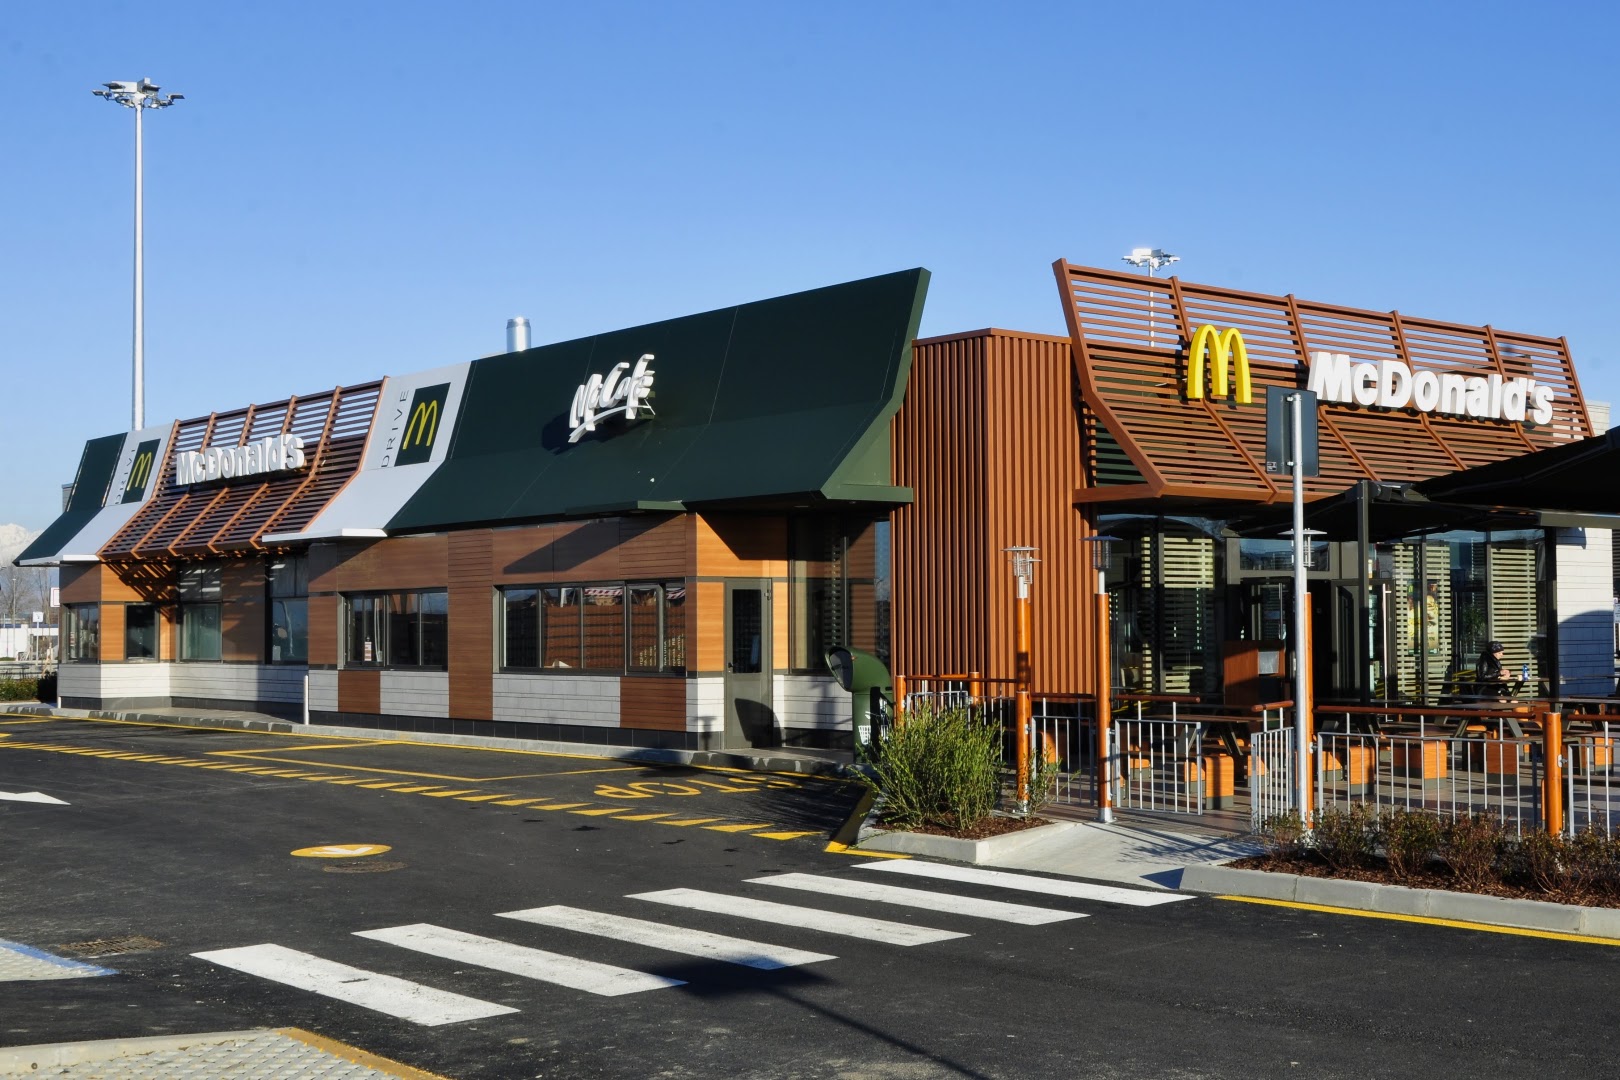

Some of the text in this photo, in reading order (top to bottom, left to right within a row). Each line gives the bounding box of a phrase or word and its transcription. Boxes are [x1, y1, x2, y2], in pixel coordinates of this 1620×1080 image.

[1307, 351, 1554, 425] McDonald's
[175, 433, 305, 486] McDonald's
[381, 389, 409, 468] DRIVE
[593, 776, 802, 799] STOP
